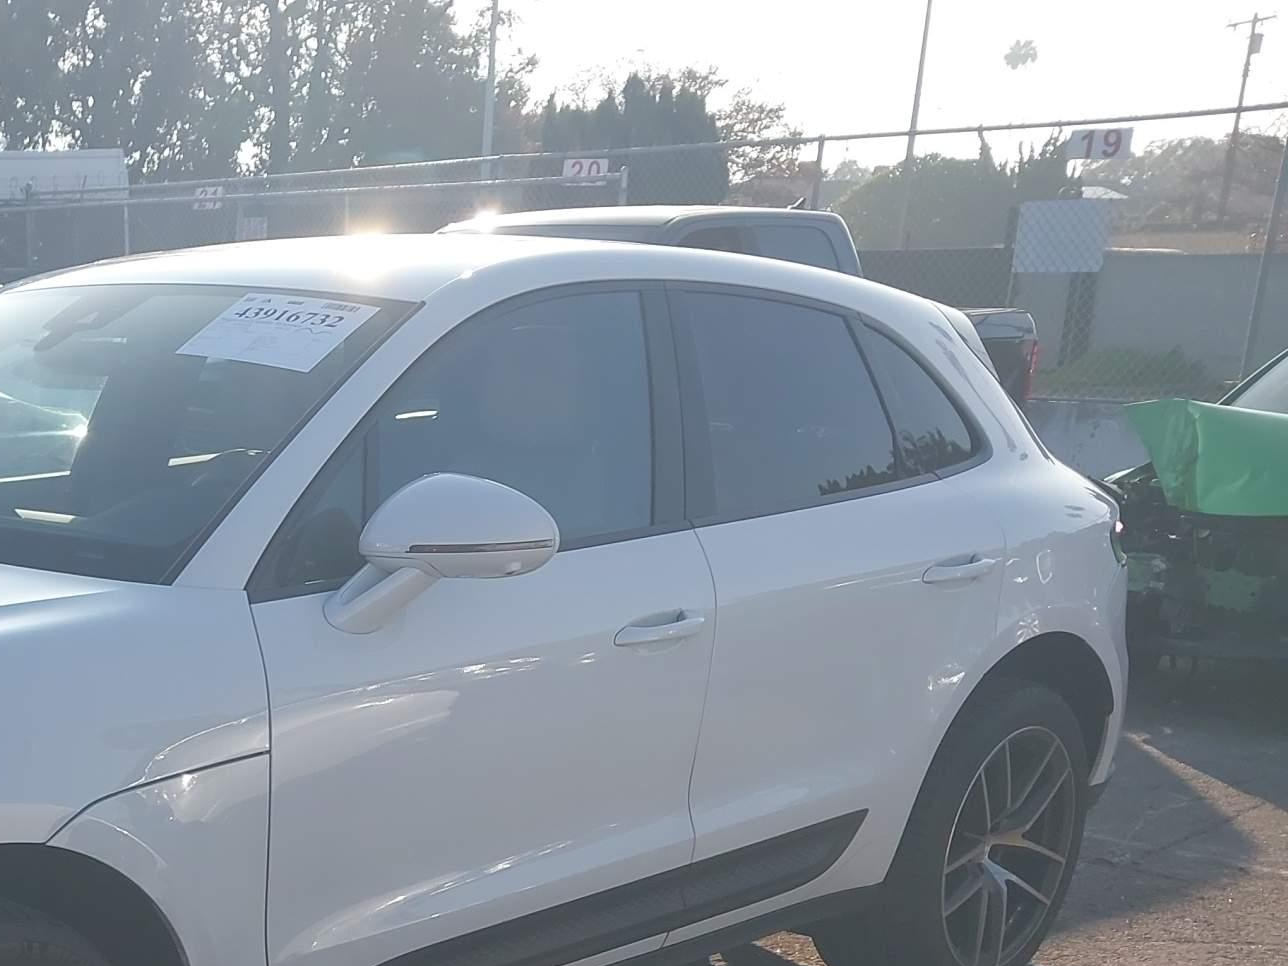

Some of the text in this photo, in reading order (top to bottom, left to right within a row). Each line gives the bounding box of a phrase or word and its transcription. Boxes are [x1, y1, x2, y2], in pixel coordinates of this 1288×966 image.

[1081, 129, 1122, 159] 19
[571, 160, 600, 177] 20
[235, 306, 345, 328] 43916732
